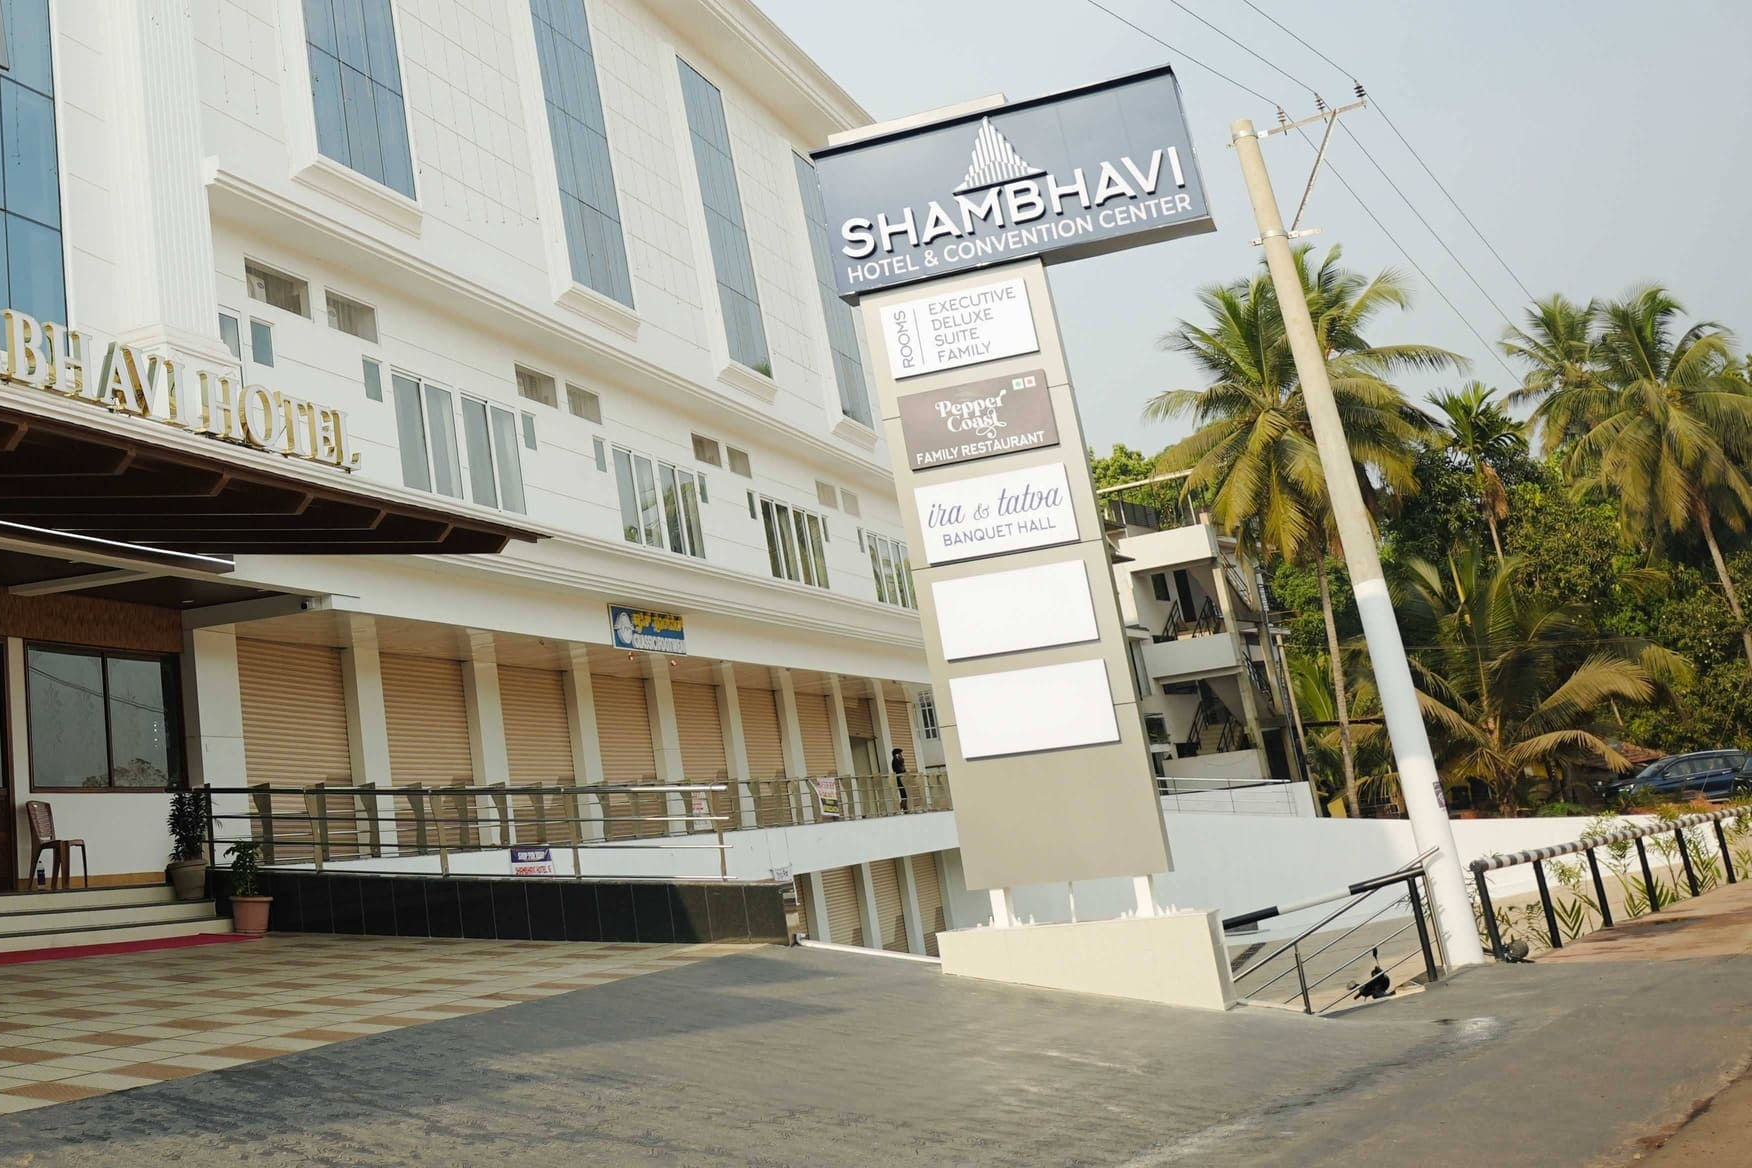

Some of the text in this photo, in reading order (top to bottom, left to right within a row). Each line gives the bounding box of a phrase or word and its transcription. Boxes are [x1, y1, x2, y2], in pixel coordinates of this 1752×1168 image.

[841, 146, 1186, 259] SHAMBHAVI
[847, 193, 1193, 285] HOTEL & CONVENTION CENTER
[928, 286, 1016, 315] EXECUTIVE
[931, 307, 994, 332] DELUXE
[893, 310, 916, 369] ROOMS
[934, 327, 980, 347] SUITE
[937, 340, 992, 363] FAMILY
[935, 389, 1007, 418] Pepper
[195, 369, 362, 472] HOTEL
[947, 409, 1007, 439] Coast
[916, 431, 1046, 465] FAMILY RESTAURANT
[928, 503, 966, 529] ira
[973, 503, 991, 521] &
[942, 517, 1057, 547] BANQUET HALL
